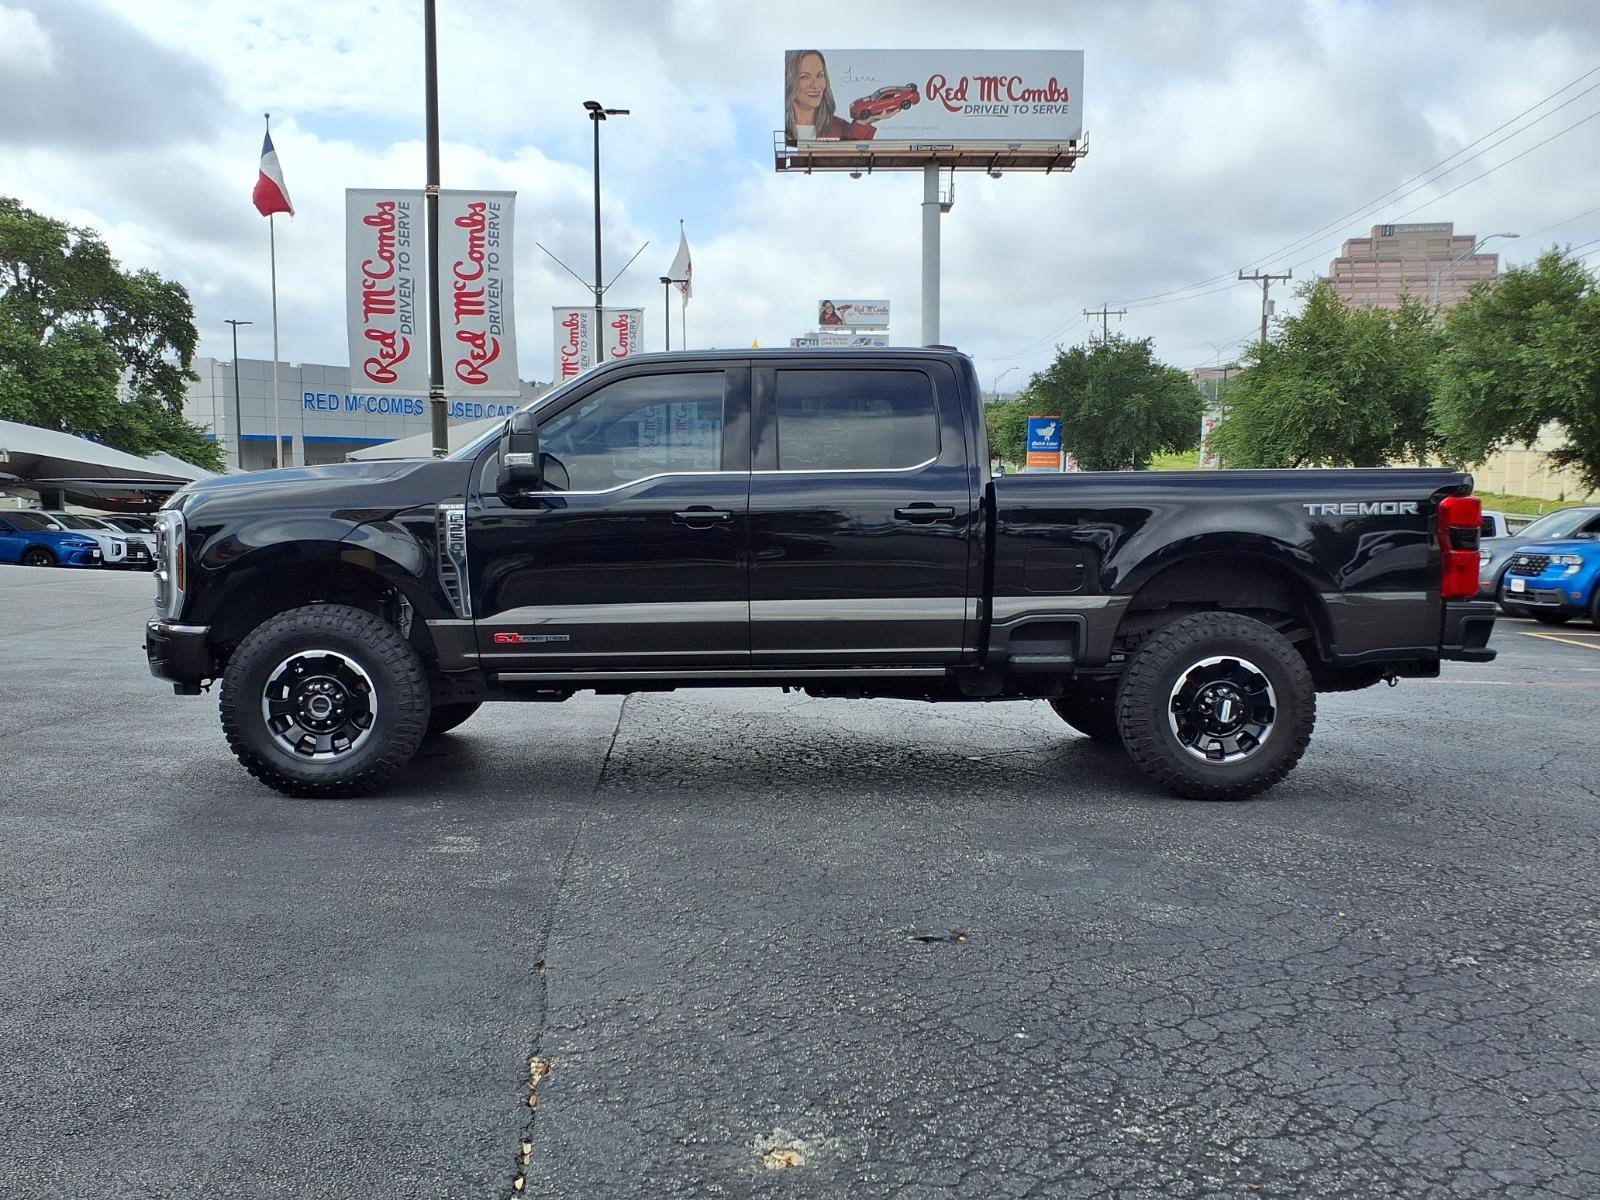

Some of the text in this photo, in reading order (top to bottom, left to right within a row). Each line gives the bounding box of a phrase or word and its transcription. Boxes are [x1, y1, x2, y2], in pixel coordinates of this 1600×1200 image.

[926, 74, 1069, 112] Red McCombs
[964, 104, 1069, 114] DRIVEN TO SERVE
[398, 201, 412, 335] DRIVEN TO SERVE
[488, 202, 501, 336] DRIVEN TO SERVE
[361, 201, 411, 384] Red McCombs
[453, 201, 501, 385] Red McCombs
[580, 312, 588, 339] SERVE
[610, 314, 629, 358] Combs
[561, 312, 579, 380] McCombs
[580, 340, 588, 352] TO
[629, 341, 637, 353] TO
[304, 392, 340, 411] RED
[447, 402, 483, 418] USED
[1303, 501, 1419, 516] TREMOR
